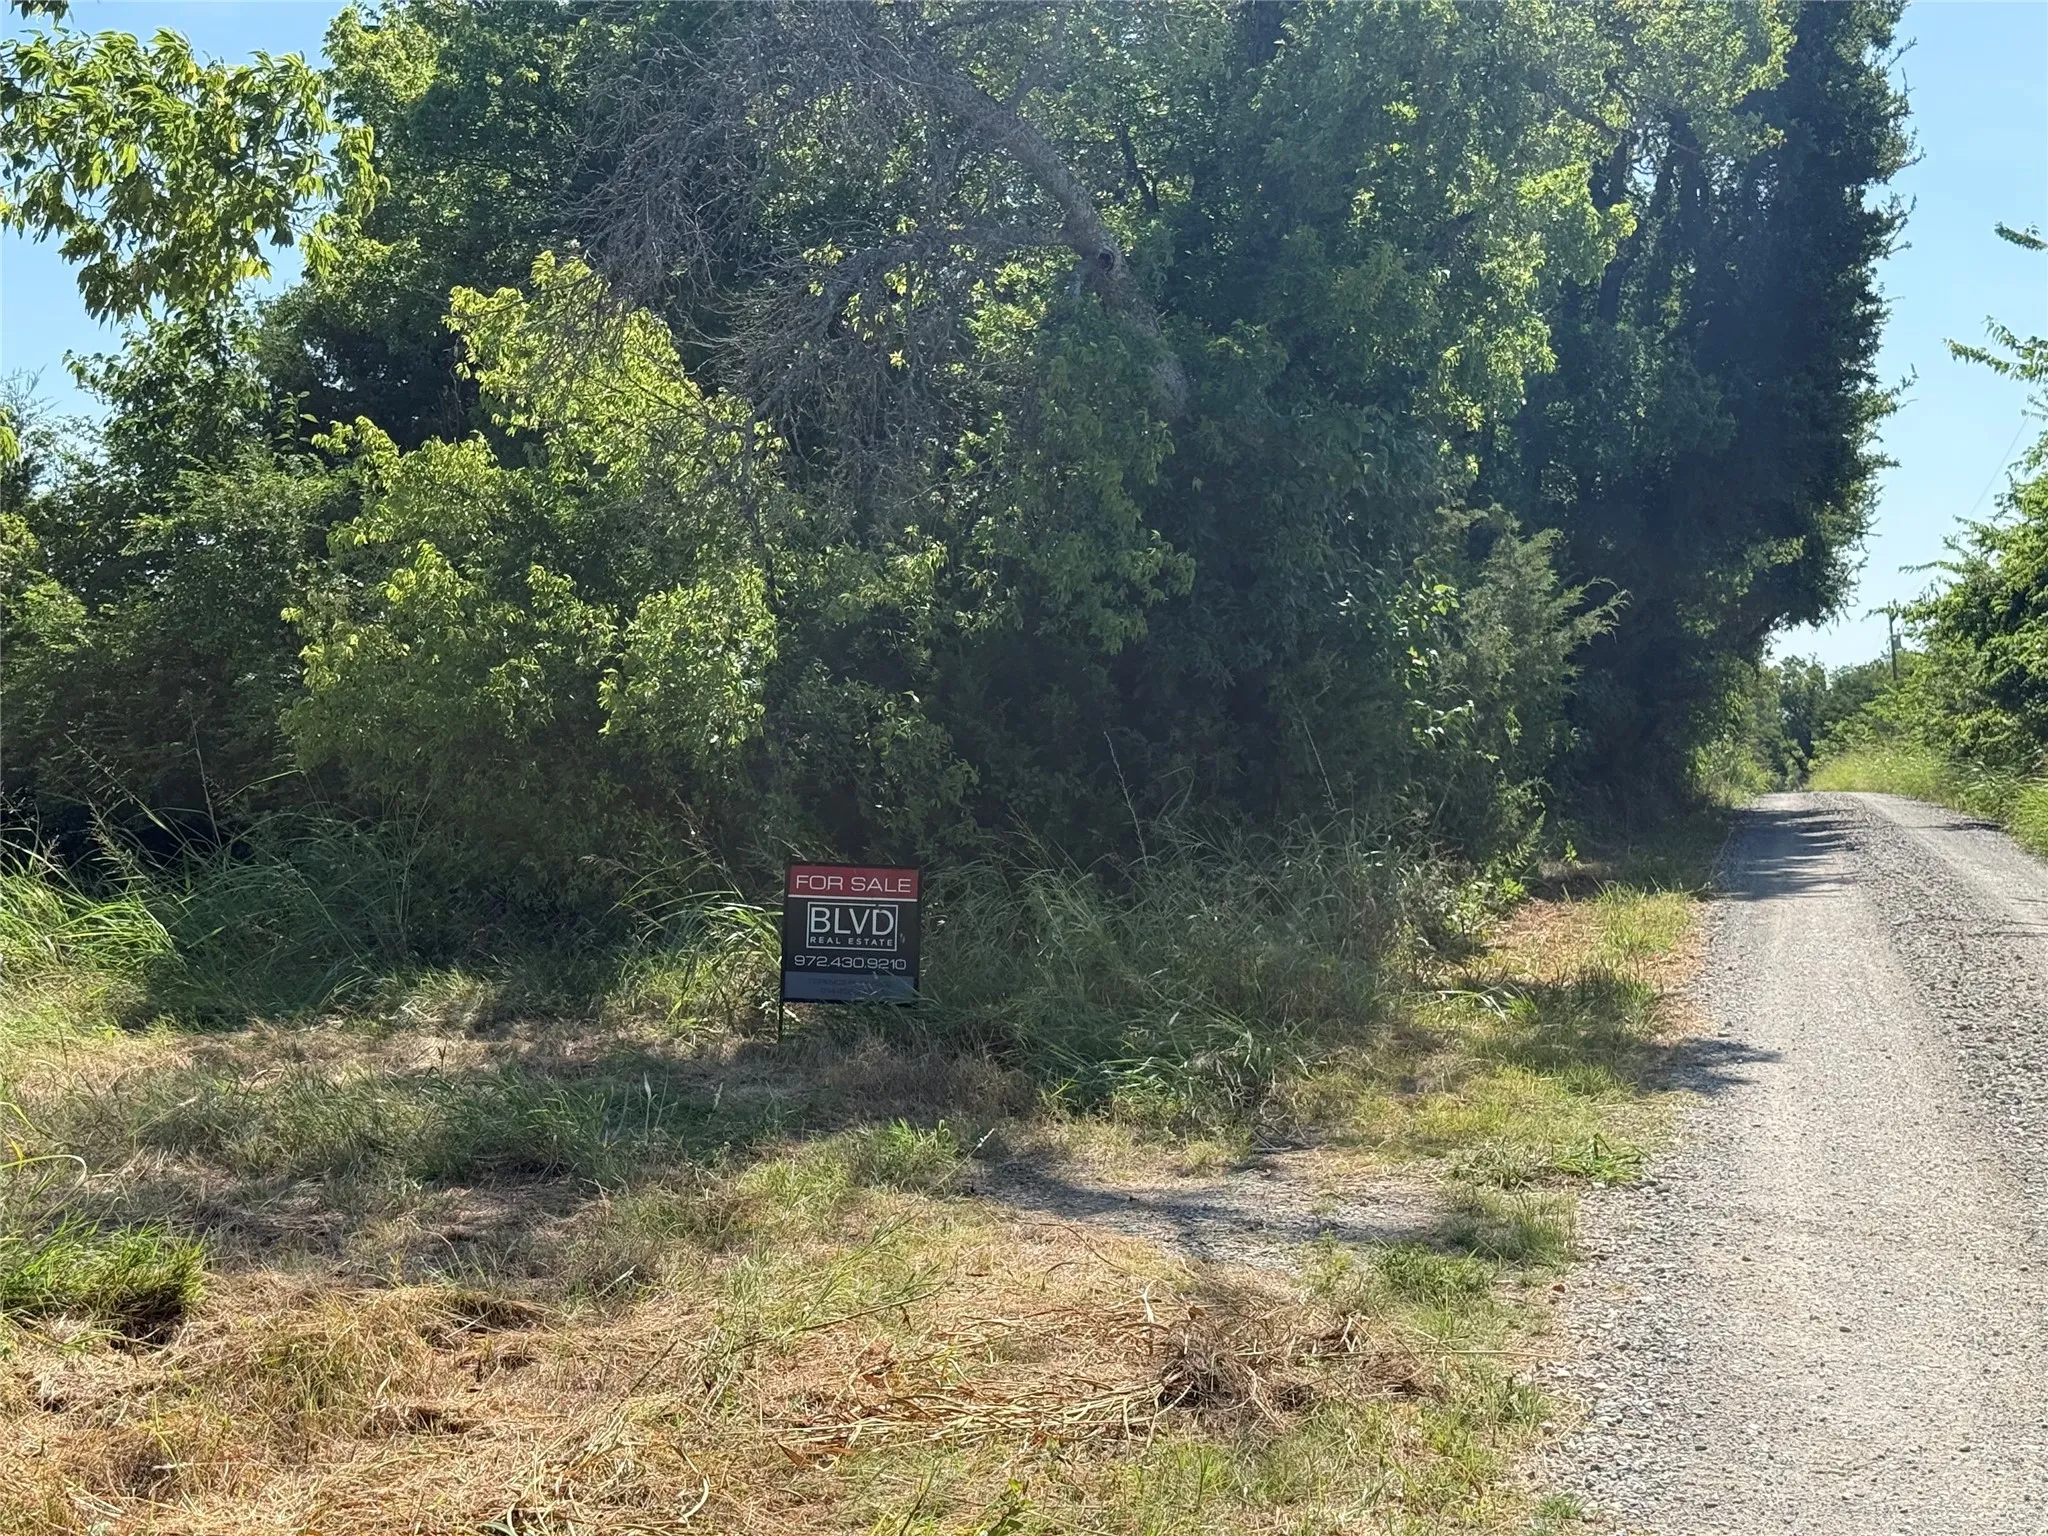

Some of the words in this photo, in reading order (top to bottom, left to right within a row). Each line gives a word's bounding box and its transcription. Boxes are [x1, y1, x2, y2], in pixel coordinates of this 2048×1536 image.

[796, 875, 843, 890] FOR
[851, 877, 911, 893] SALE
[810, 907, 894, 935] BLVD
[810, 936, 841, 944] REAL
[848, 938, 893, 946] ESTATE
[794, 955, 907, 970] 972.430.9210
